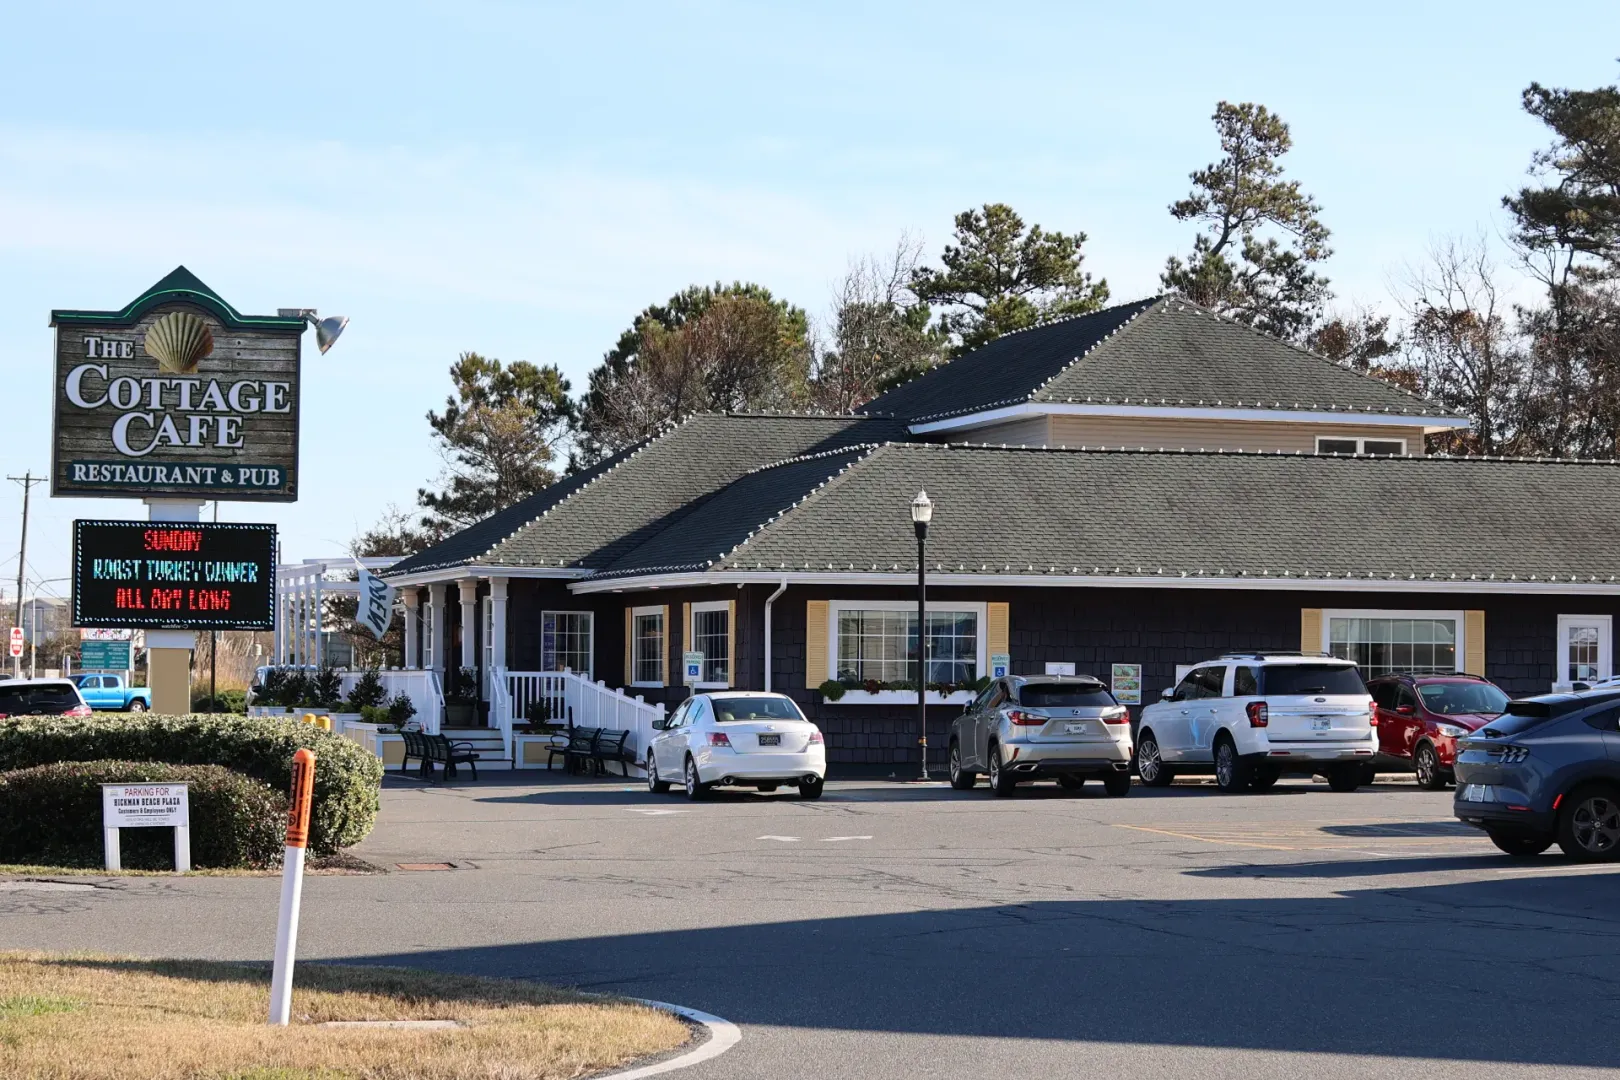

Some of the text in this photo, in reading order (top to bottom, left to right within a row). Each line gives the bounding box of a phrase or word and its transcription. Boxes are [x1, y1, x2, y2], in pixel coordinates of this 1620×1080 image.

[84, 337, 134, 359] THE
[65, 364, 291, 413] COTTAGE
[112, 412, 244, 457] CAFE
[73, 464, 280, 486] RESTAURANT & PUB
[144, 530, 202, 551] SUNDAY
[116, 588, 145, 609] ALL
[189, 589, 231, 610] LONG
[125, 788, 154, 797] PARKING
[155, 787, 170, 796] FOR
[142, 797, 160, 806] BEACH
[162, 797, 180, 805] PLAZA
